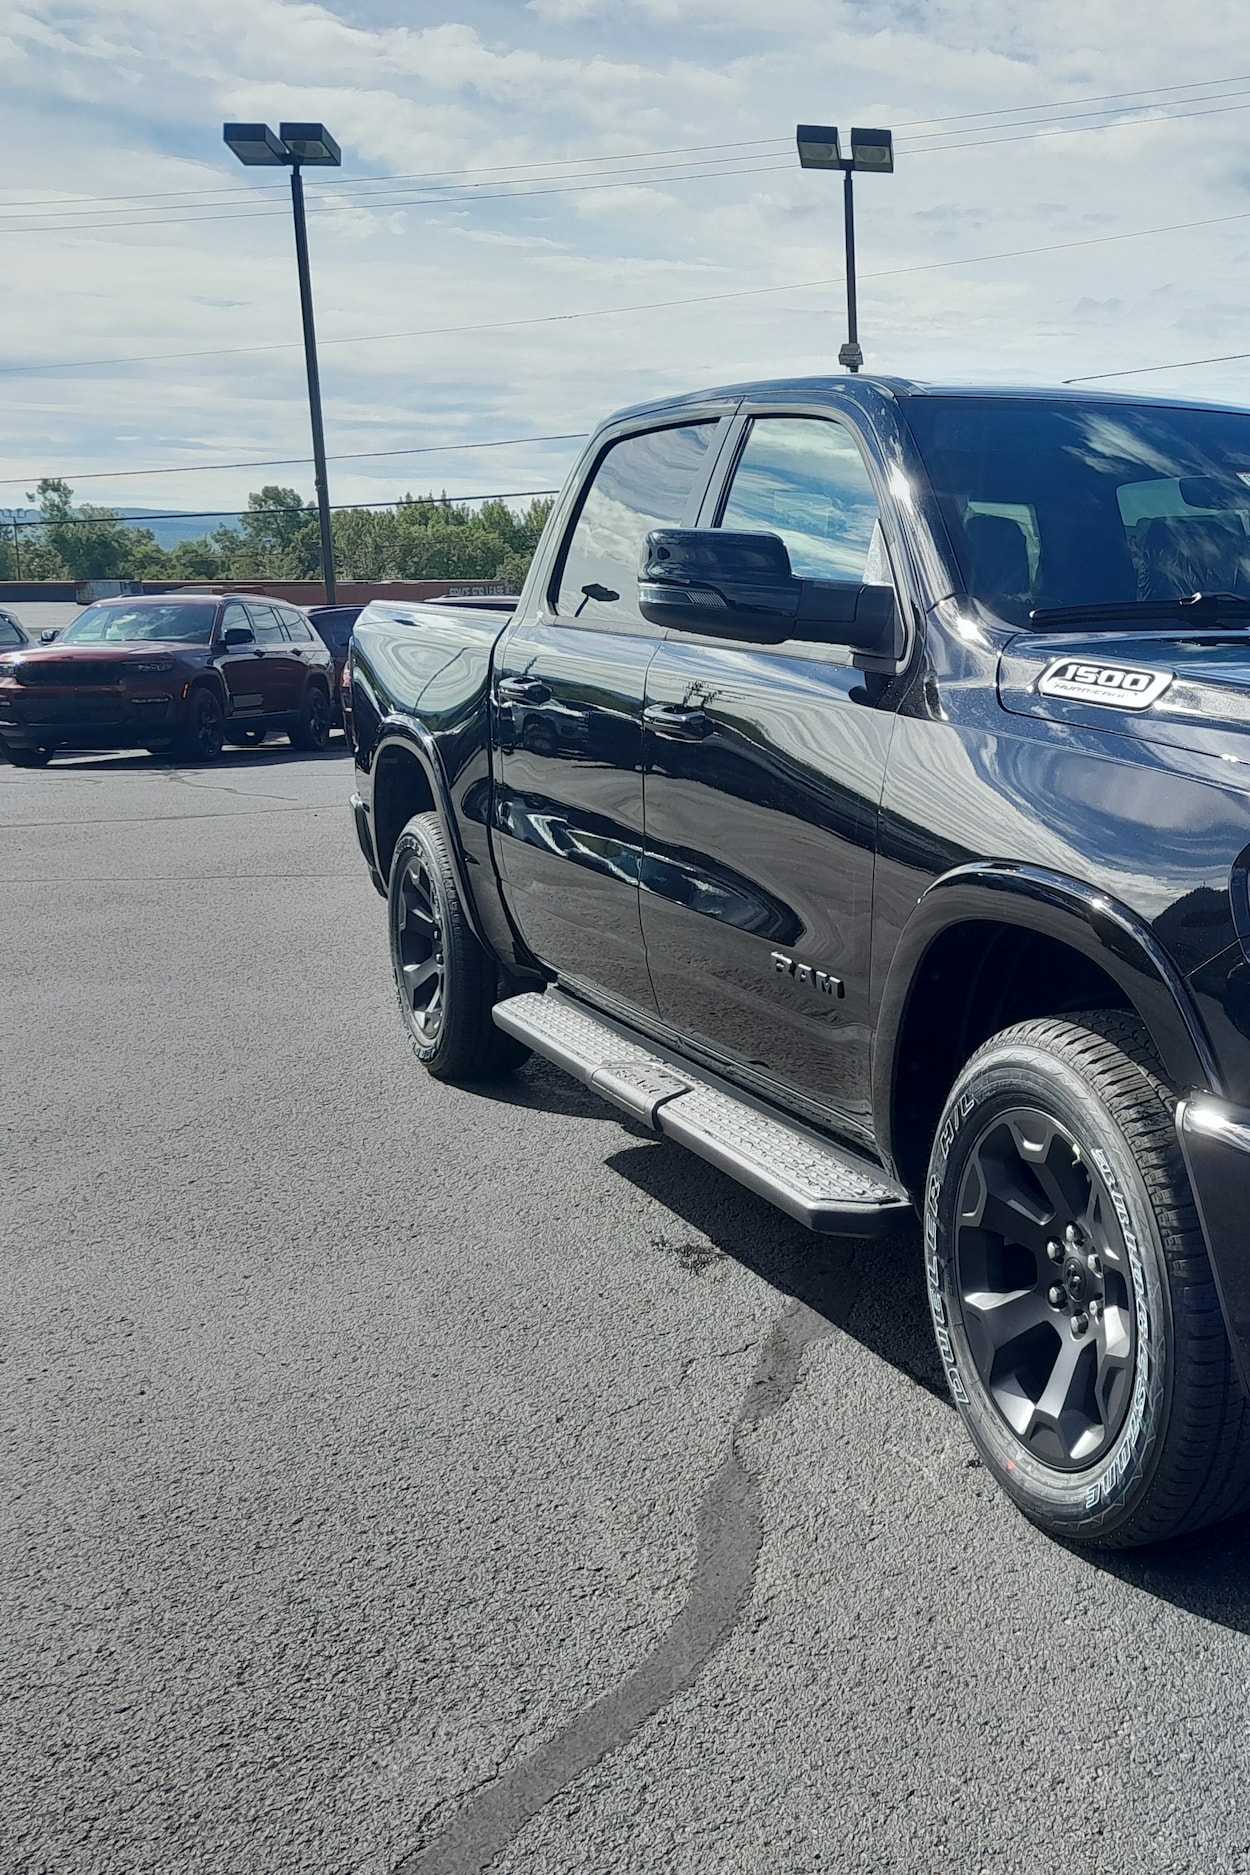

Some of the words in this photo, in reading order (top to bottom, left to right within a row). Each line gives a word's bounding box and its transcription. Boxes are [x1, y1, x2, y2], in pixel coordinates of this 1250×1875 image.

[1065, 664, 1152, 692] 1500
[770, 950, 846, 999] RAM
[925, 1174, 971, 1404] DUELER
[1086, 1148, 1150, 1509] BRIDGESTONE
